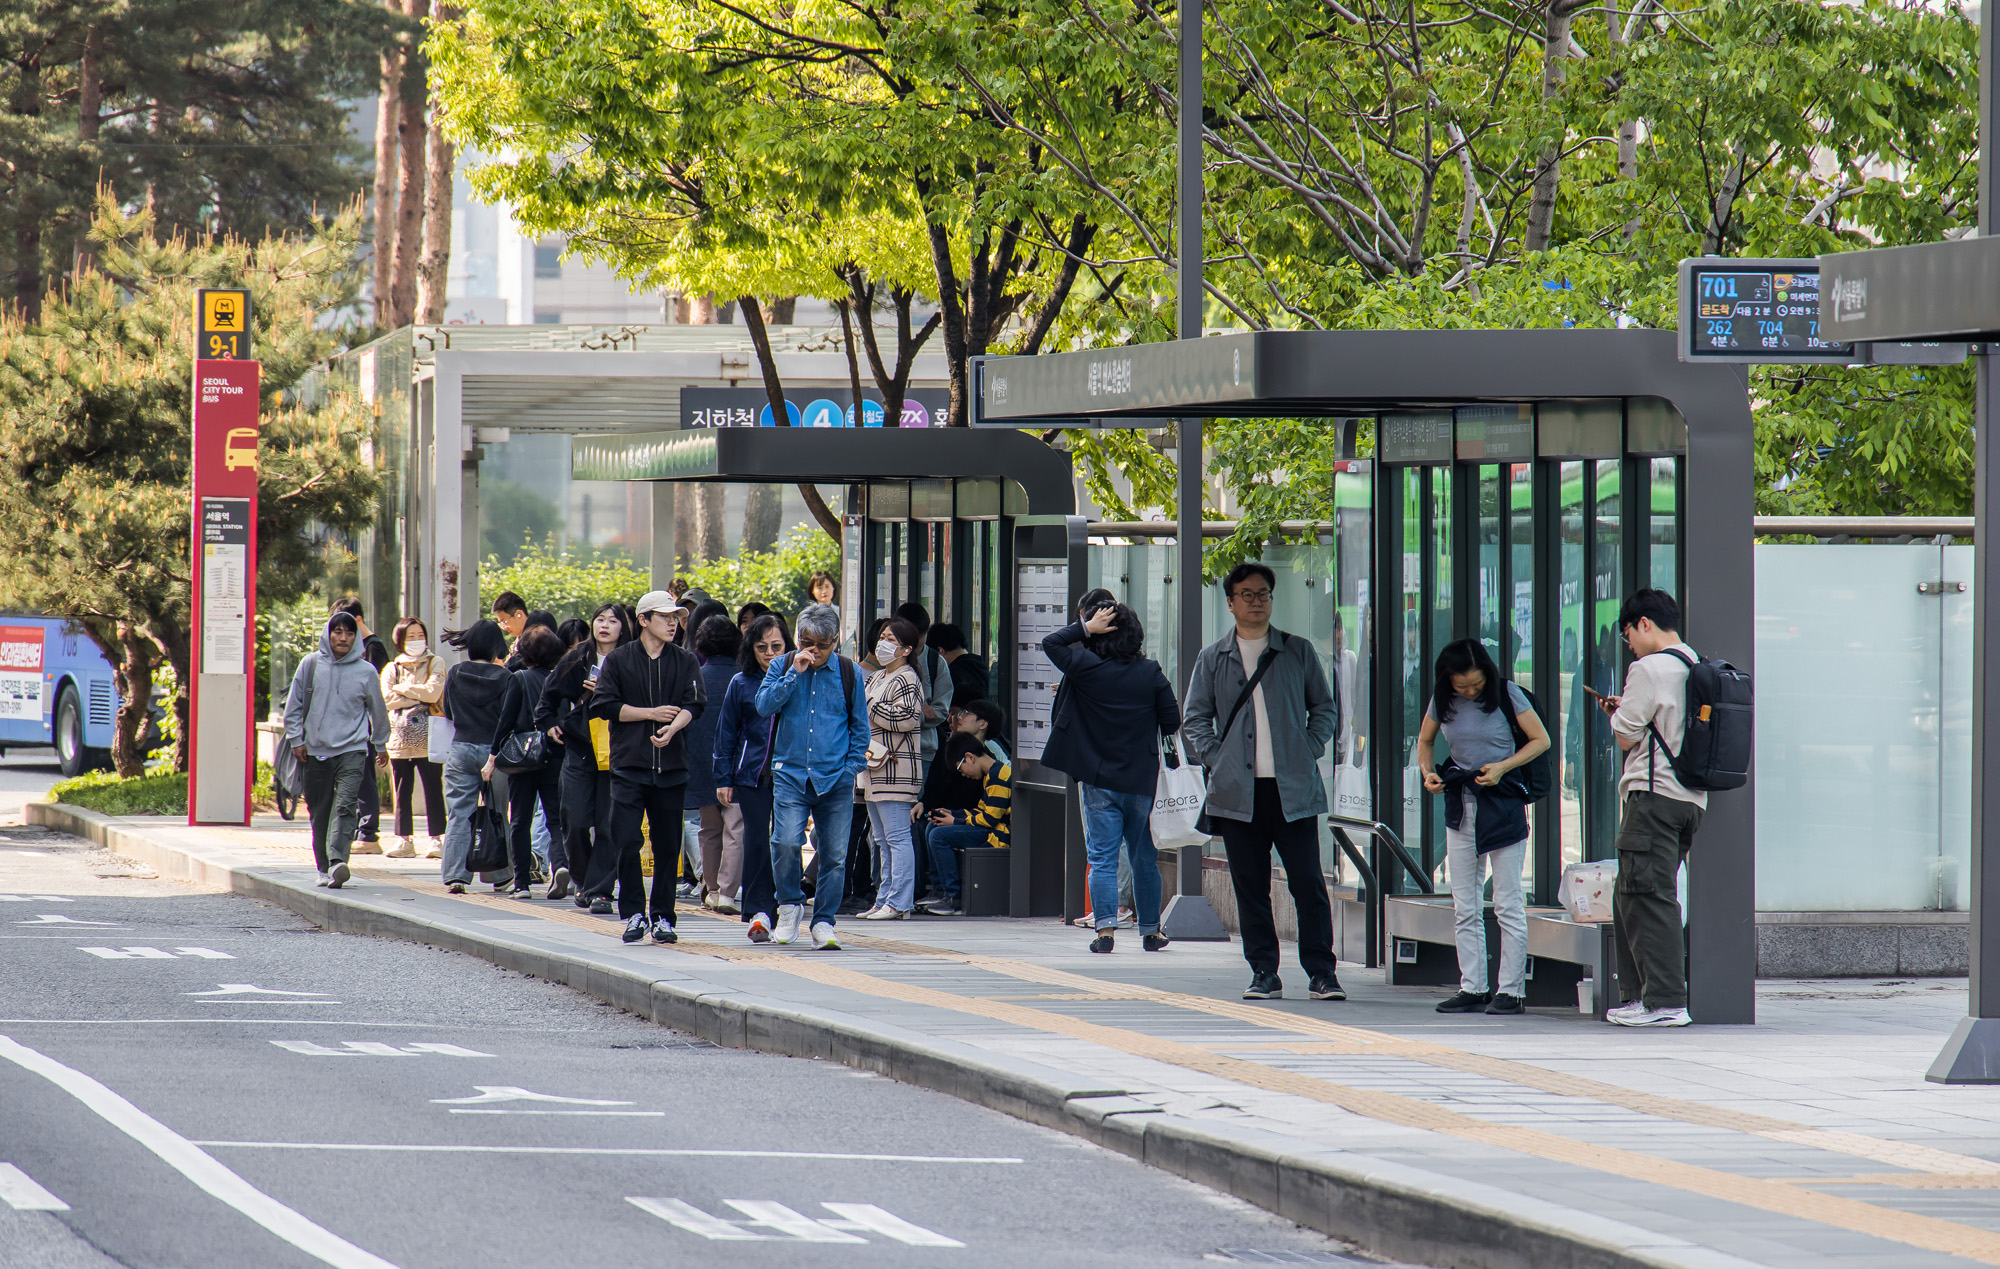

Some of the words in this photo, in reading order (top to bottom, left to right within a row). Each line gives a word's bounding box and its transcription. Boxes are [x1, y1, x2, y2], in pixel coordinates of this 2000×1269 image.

[1701, 277, 1739, 298] 701
[1701, 304, 1730, 316] 곧도착
[1736, 306, 1752, 316] 다음
[1754, 307, 1761, 316] 2
[1706, 320, 1733, 335] 262
[1757, 320, 1784, 335] 704
[209, 334, 238, 357] 9-1
[1710, 336, 1728, 348] 4분
[1761, 336, 1778, 348] 6분
[202, 377, 230, 386] SEOUL
[202, 386, 220, 395] CITY
[221, 386, 244, 395] TOUR
[202, 394, 220, 403] BUS
[691, 407, 755, 428] 지하철
[812, 408, 832, 428] 4
[205, 511, 230, 522] 서울역
[1155, 794, 1199, 809] creora
